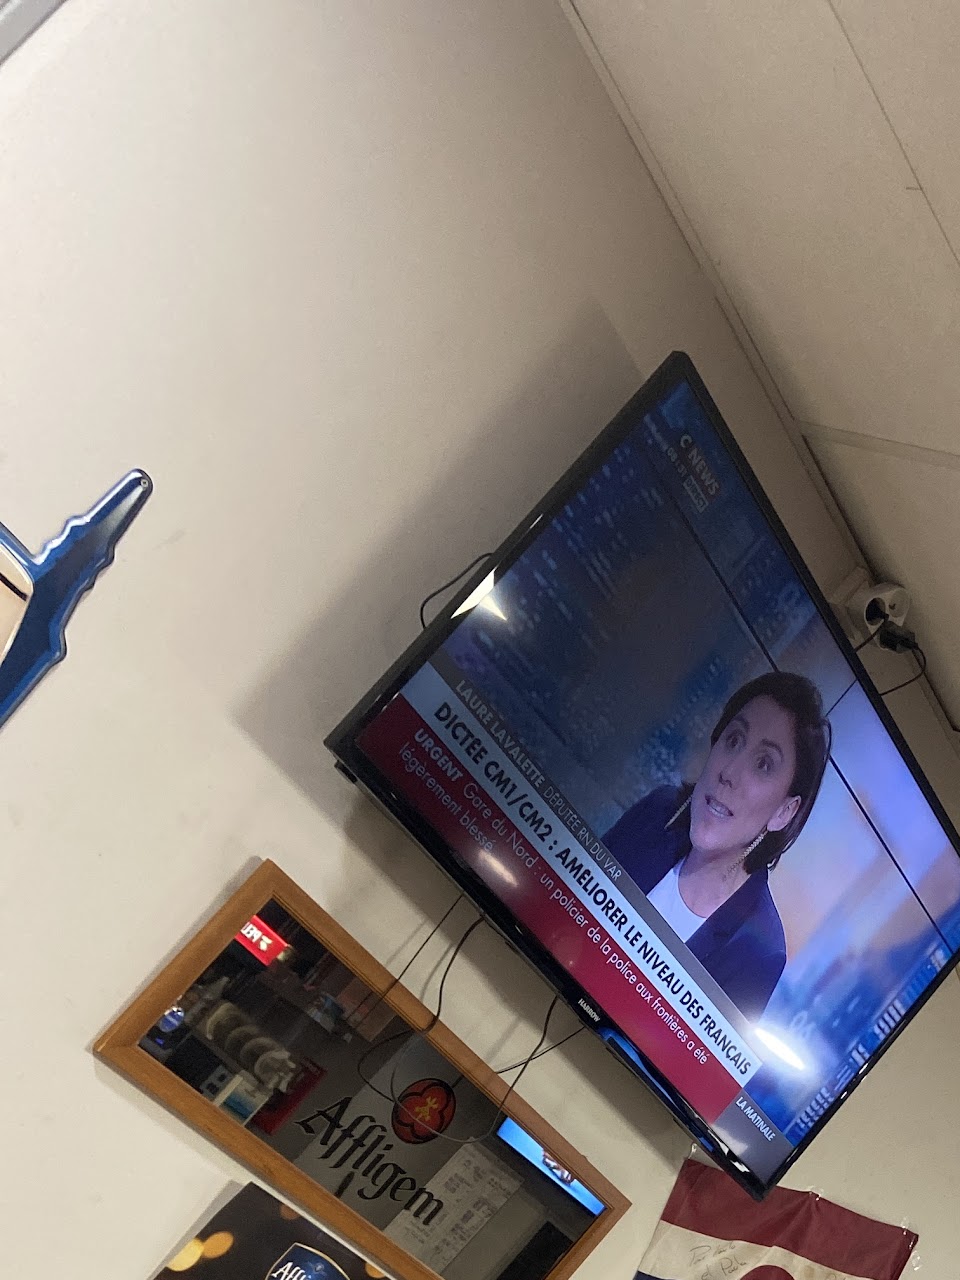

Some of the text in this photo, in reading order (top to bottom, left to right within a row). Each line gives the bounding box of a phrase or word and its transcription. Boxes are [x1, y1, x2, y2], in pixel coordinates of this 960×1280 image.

[412, 727, 463, 784] URGENT
[392, 741, 464, 821] légèrement
[453, 679, 623, 881] LAURE LAVALETTE DÉPUTÉE RN DU VAR
[460, 780, 497, 820] Gare
[489, 814, 511, 837] du
[504, 830, 540, 869] Nord
[431, 700, 489, 764] DICTÉE
[478, 757, 557, 844] CM1/CM2
[554, 844, 630, 930] AMÉLIORER
[622, 925, 644, 947] LE
[636, 941, 686, 996] NIVEAU
[677, 990, 706, 1019] DES
[697, 1013, 753, 1076] FRANÇAIS
[538, 872, 555, 890] un
[548, 885, 592, 931] policier
[585, 923, 605, 944] de
[598, 938, 615, 955] la
[605, 949, 641, 988] police
[634, 981, 656, 1004] aux
[649, 996, 692, 1043] frontières
[684, 1040, 695, 1050] a
[692, 1045, 711, 1064] été
[735, 1096, 776, 1141] LA MATINALE
[294, 1094, 447, 1227] Affligem
